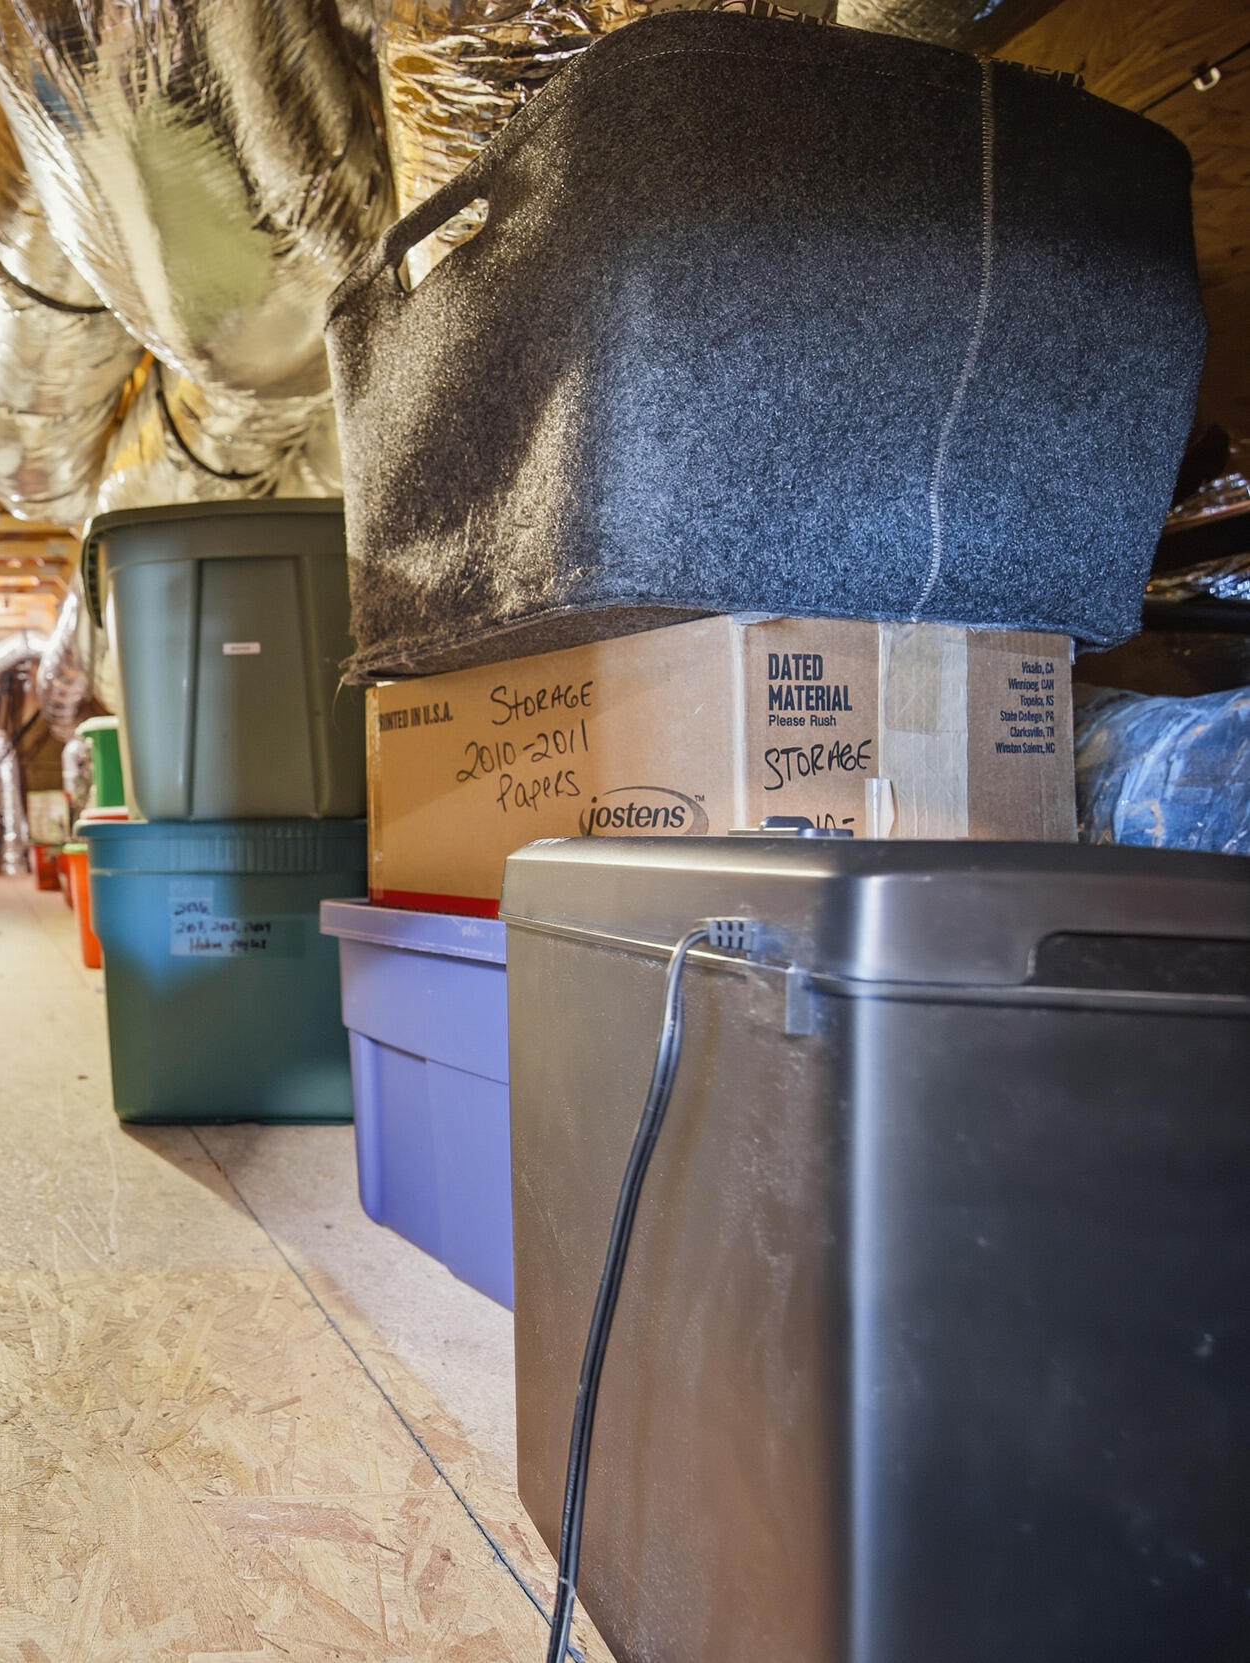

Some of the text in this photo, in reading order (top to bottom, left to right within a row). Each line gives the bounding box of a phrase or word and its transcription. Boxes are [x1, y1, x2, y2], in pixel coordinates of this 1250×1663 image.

[768, 653, 823, 681] DATED
[768, 684, 852, 711] MATERIAL
[411, 706, 421, 727] IN
[423, 701, 454, 726] U.S.A.
[768, 714, 837, 727] Please Rush
[456, 718, 589, 783] 2010-2011
[1046, 743, 1055, 754] NC
[763, 739, 872, 791] STORAGE
[588, 796, 686, 836] jostens
